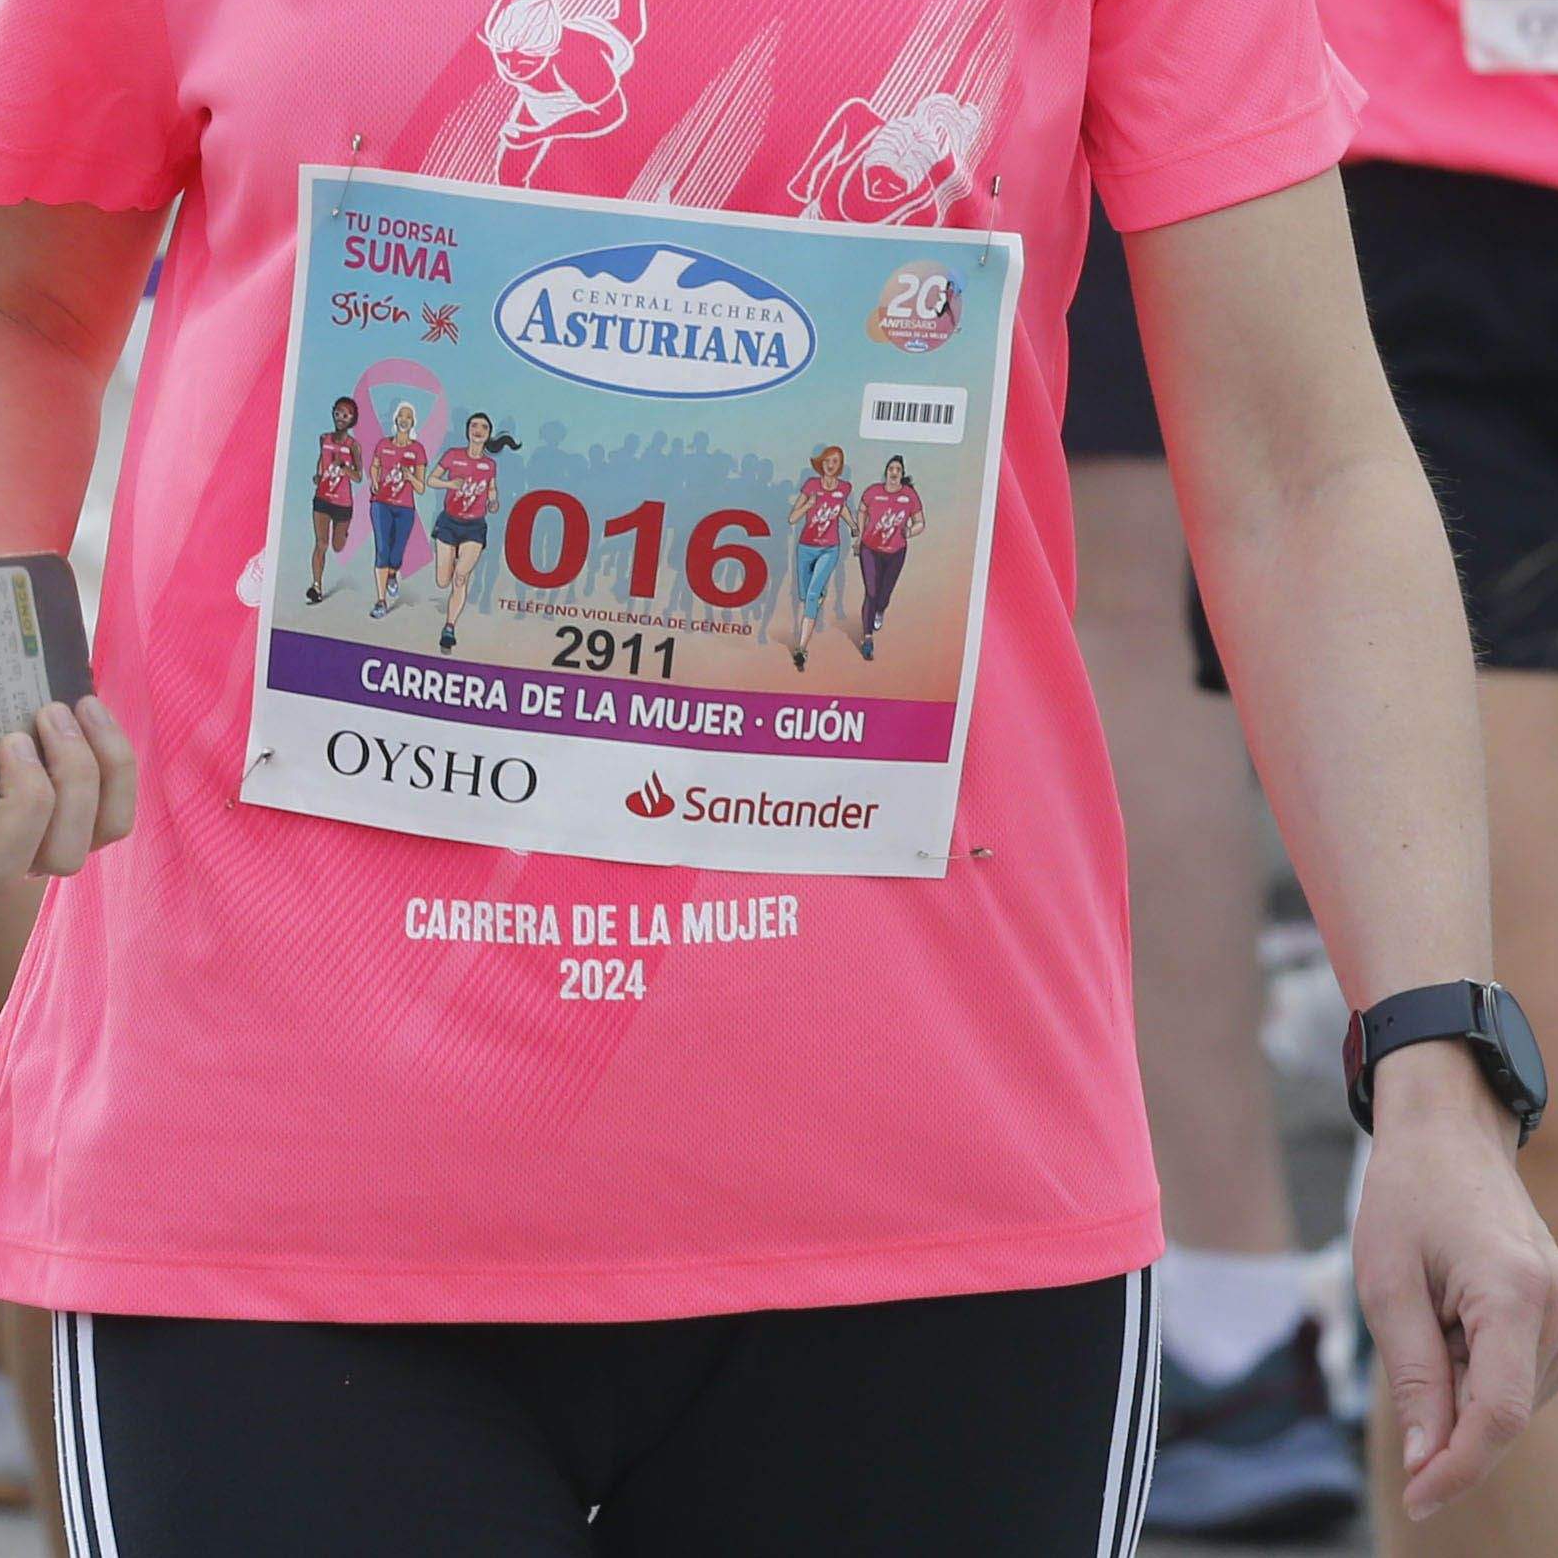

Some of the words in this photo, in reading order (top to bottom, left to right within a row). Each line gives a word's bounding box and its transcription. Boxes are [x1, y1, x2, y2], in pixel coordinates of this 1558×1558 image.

[345, 211, 371, 233] TU
[378, 216, 458, 248] DORSAL
[344, 235, 452, 284] SUMA
[331, 291, 410, 330] gijón
[572, 288, 673, 312] CENTRAL
[683, 300, 785, 324] LECHERA
[887, 274, 948, 319] 20
[516, 287, 790, 369] ASTURIANA
[504, 489, 771, 609] 016
[498, 597, 579, 618] TELÉFONO
[582, 608, 664, 628] VIOLENCIA
[667, 617, 687, 630] DE
[690, 618, 753, 636] GÉNERO
[551, 625, 676, 679] 2911
[361, 658, 509, 713] CARRERA
[520, 682, 565, 718] DE
[574, 688, 617, 725] LA
[629, 693, 745, 737] MUJER
[774, 699, 865, 743] GIJÓN
[326, 729, 538, 804] OYSHO
[681, 785, 880, 830] Santander
[405, 897, 562, 947] CARRERA
[571, 903, 618, 947] DE
[629, 903, 672, 947] LA
[681, 893, 800, 945] MUJER
[559, 957, 647, 1001] 2024
